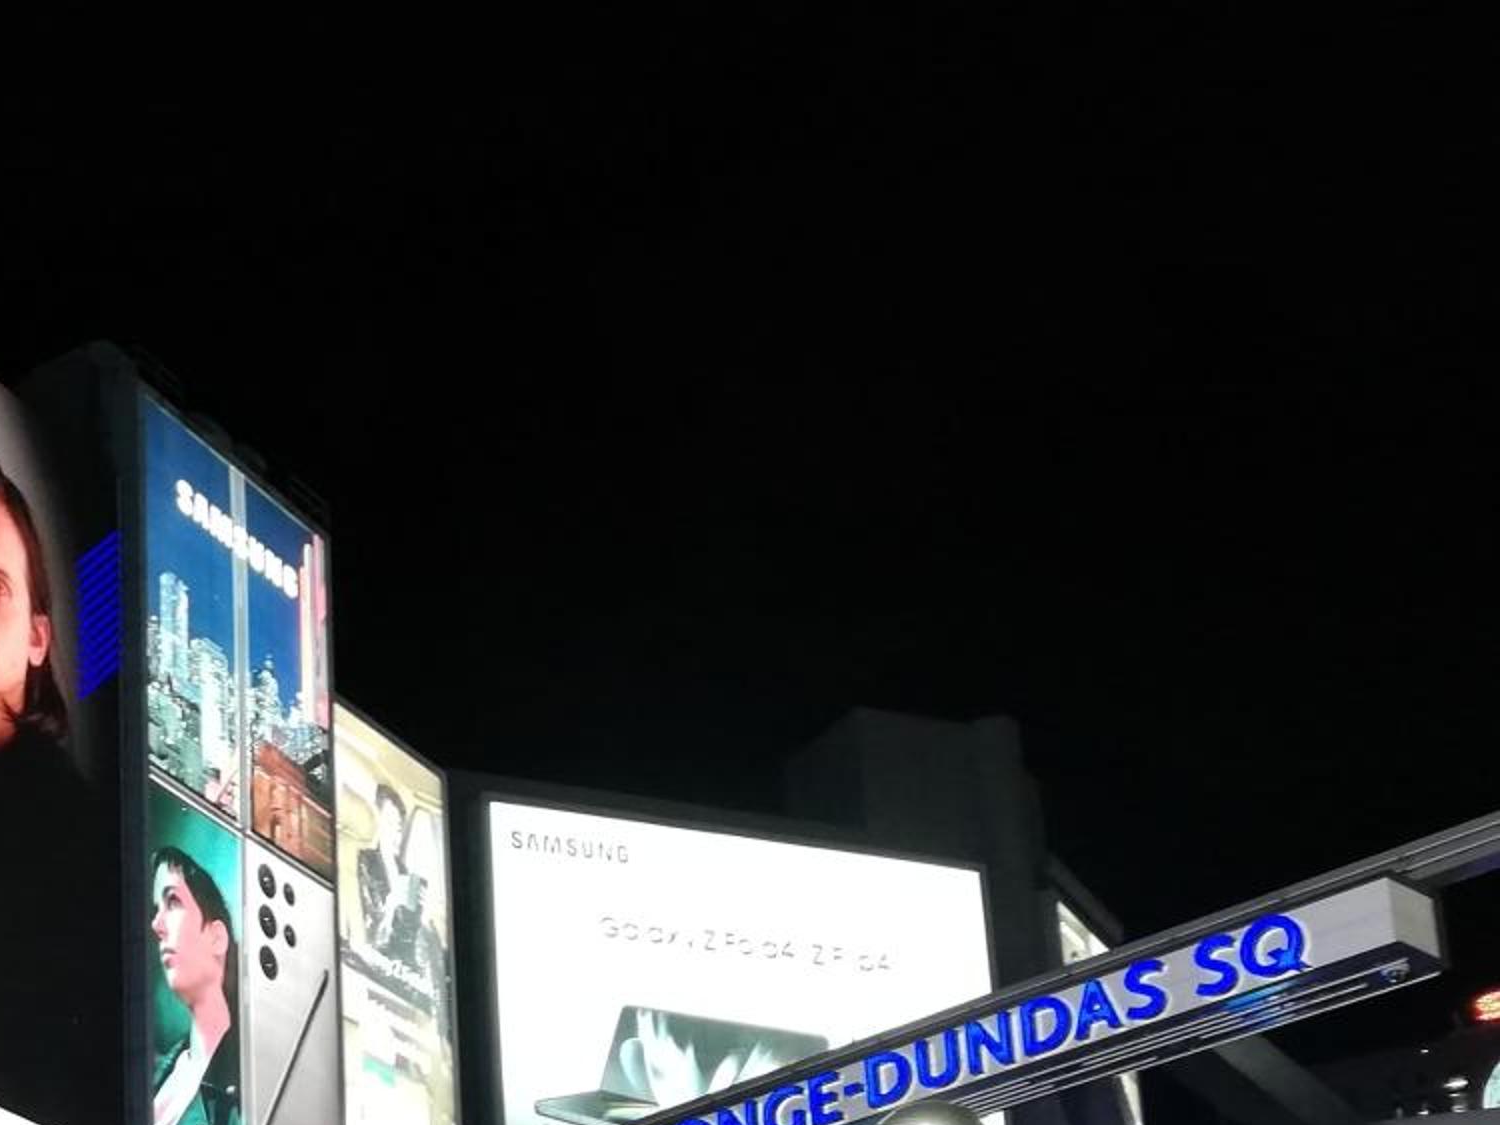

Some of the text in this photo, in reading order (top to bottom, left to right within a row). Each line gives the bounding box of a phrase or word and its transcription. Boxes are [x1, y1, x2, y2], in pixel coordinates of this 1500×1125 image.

[176, 479, 299, 599] SAMSUNG
[511, 829, 629, 864] SAMSUNG
[1195, 913, 1313, 997] SQ
